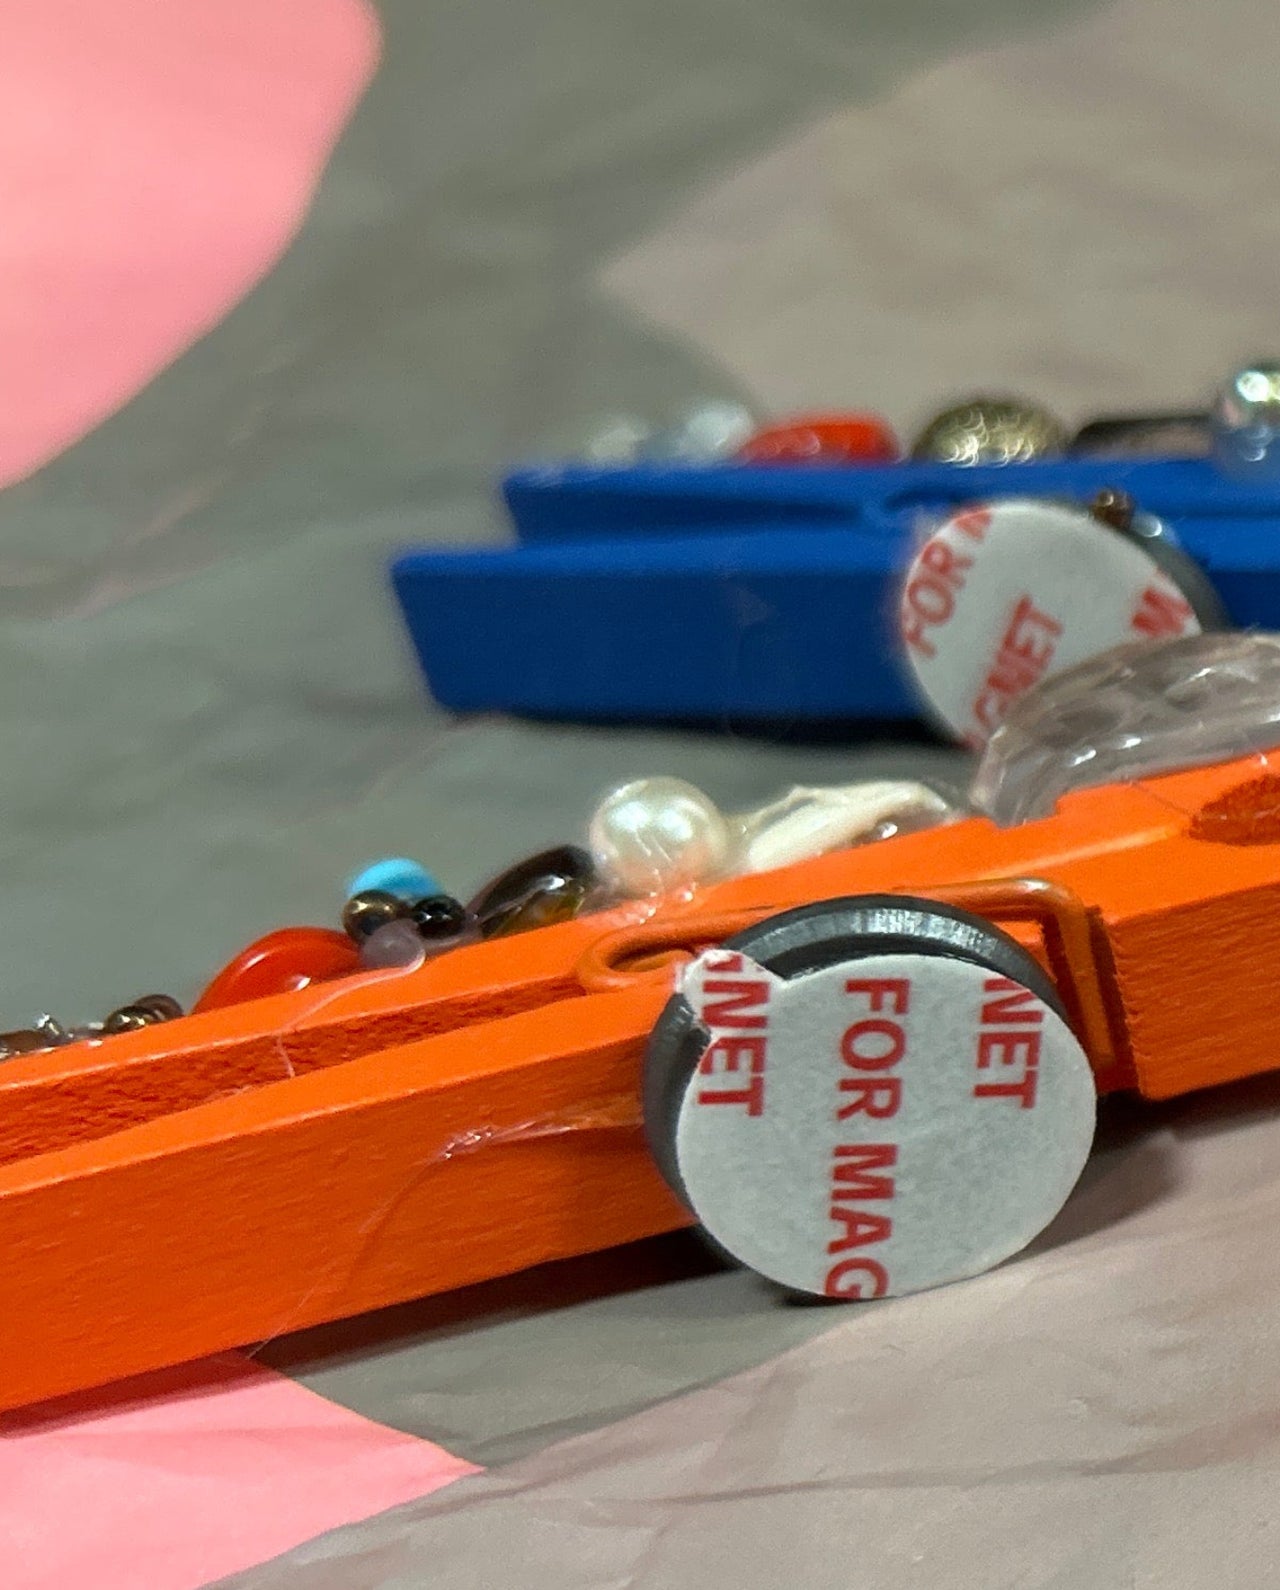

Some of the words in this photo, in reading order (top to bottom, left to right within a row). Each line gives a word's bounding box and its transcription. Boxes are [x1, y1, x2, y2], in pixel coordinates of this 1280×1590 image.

[902, 539, 972, 655] FOR
[836, 978, 910, 1120] FOR
[823, 1143, 898, 1299] MAG
